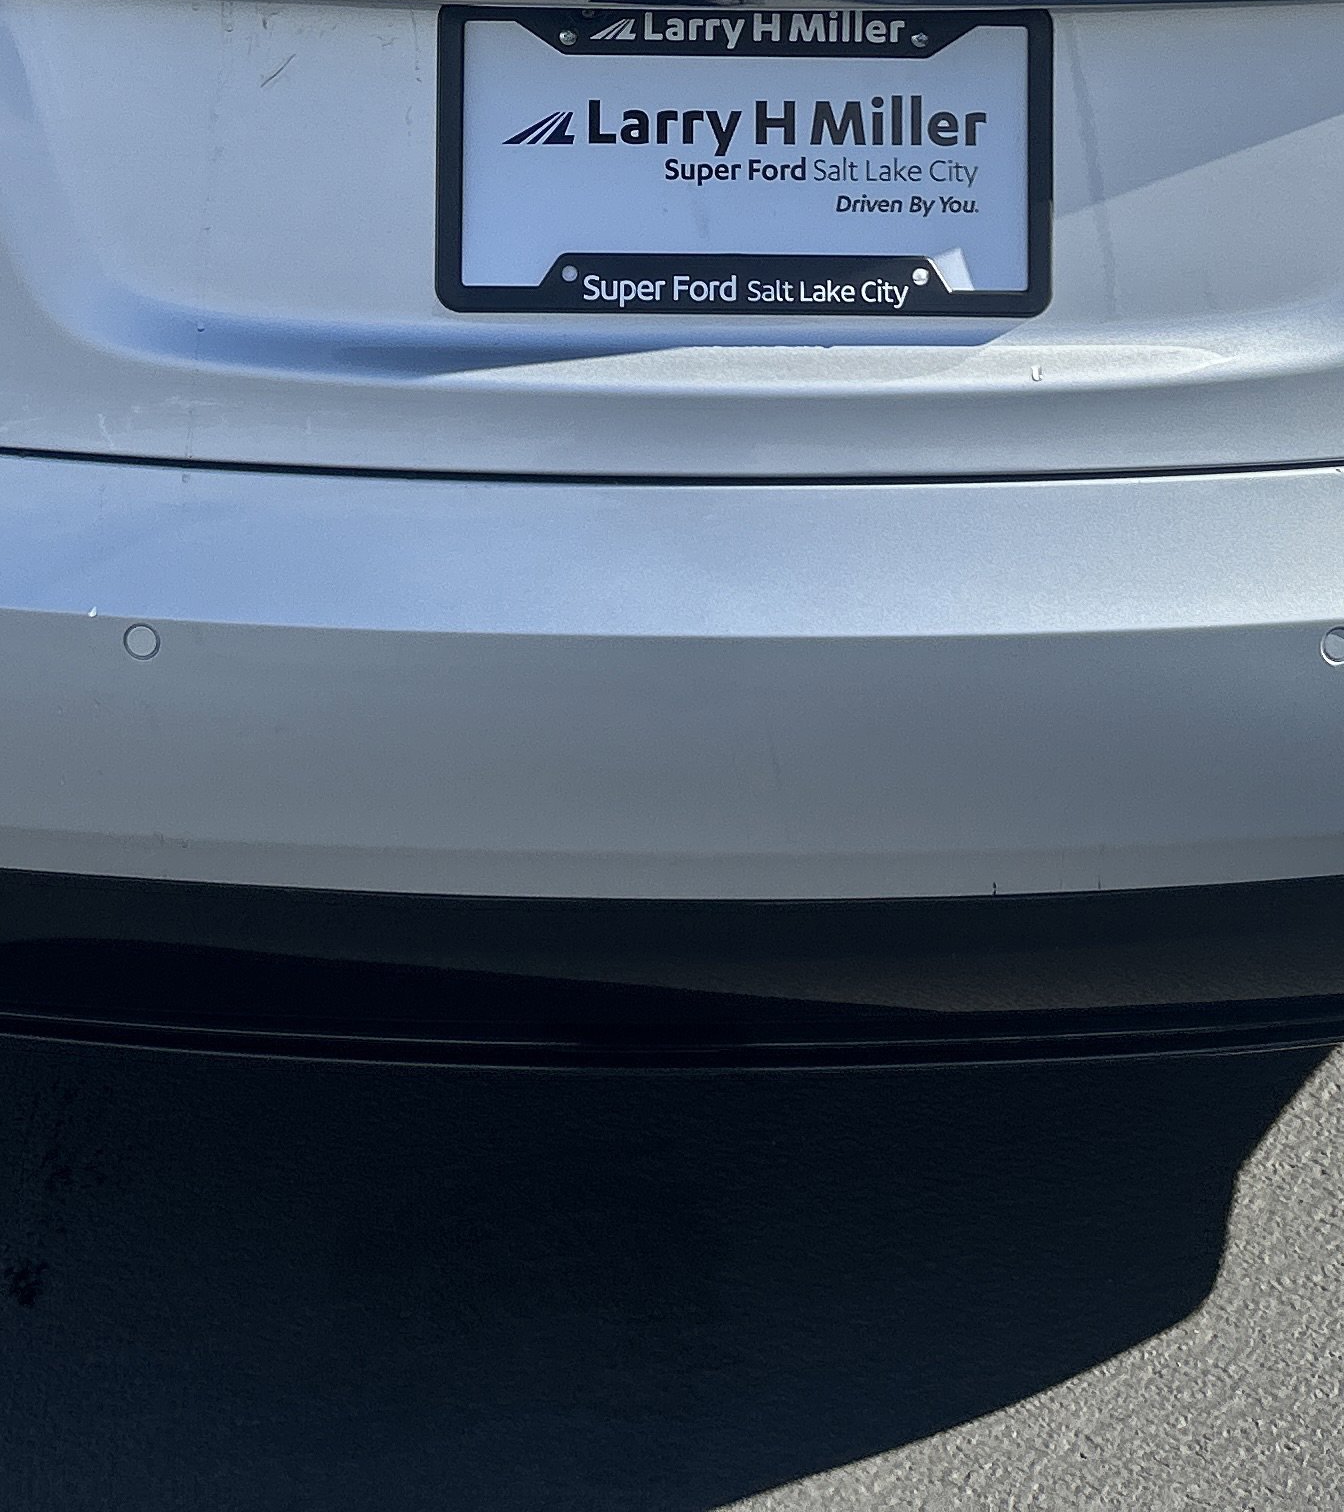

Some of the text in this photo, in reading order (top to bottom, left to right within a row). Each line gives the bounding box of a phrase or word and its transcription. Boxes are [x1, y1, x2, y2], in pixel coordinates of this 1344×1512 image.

[643, 9, 905, 49] Larry H Miller
[587, 95, 988, 157] Larry H Miller
[664, 157, 979, 188] Super Ford Salt Lake City
[835, 194, 980, 217] Driven By You.
[583, 274, 909, 309] Super Ford Salt Lake City
